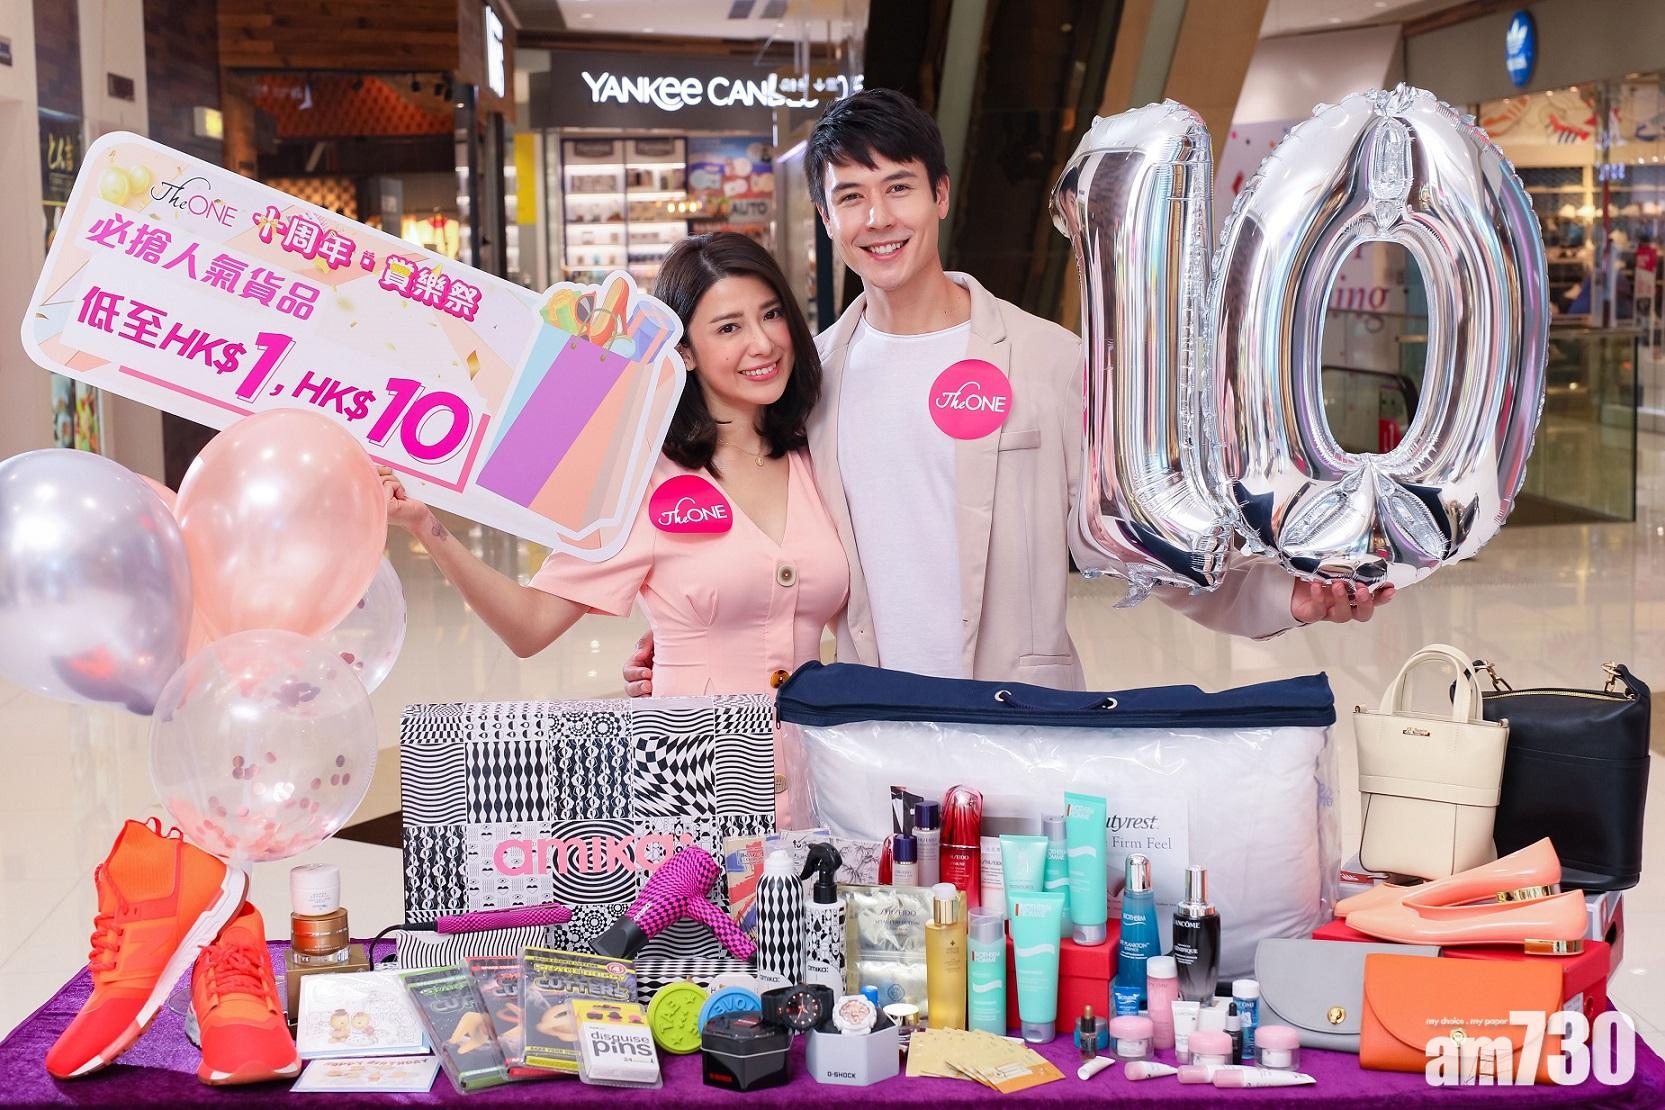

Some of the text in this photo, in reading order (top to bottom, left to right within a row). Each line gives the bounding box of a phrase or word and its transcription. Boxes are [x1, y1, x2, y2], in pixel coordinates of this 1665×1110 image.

[85, 212, 321, 321] 必搶人氣貨品
[252, 205, 483, 323] 十周年 賞樂祭
[1112, 835, 1173, 850] Firm Feel
[593, 1039, 653, 1057] pins
